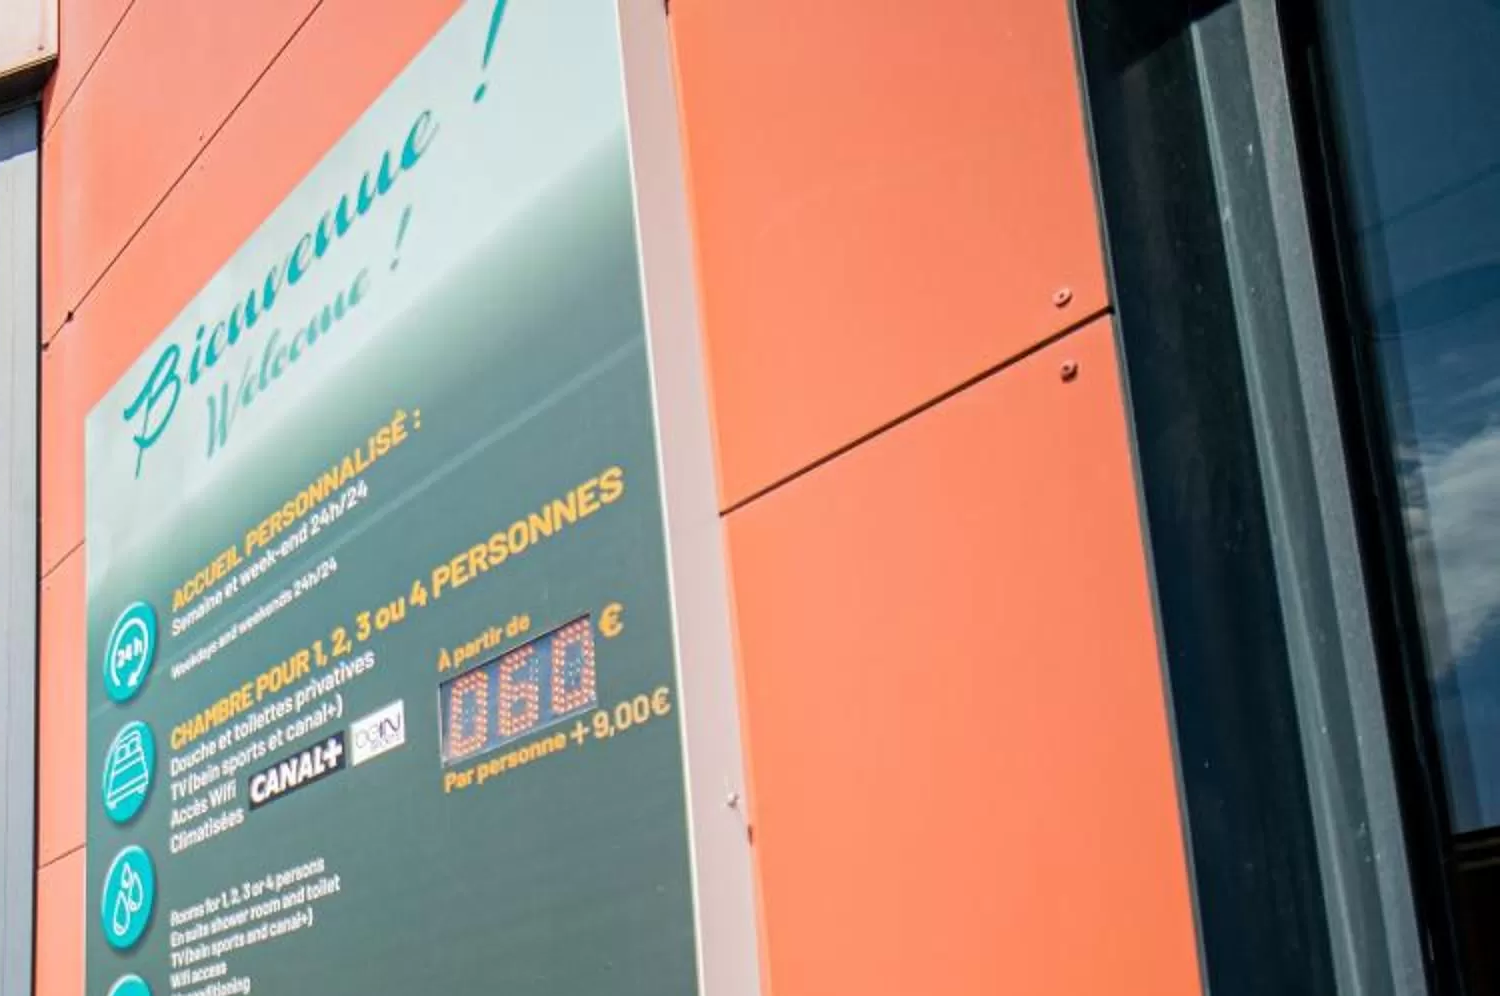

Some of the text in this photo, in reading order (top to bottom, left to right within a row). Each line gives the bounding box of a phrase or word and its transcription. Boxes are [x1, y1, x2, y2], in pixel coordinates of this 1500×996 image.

[123, 109, 438, 479] Bienvenue
[206, 268, 370, 459] Welcome
[171, 544, 243, 613] ACCUEIL
[245, 408, 408, 557] PERSONNALISÉ
[171, 479, 368, 637] Semaine et week-end 24h/24
[293, 556, 338, 598] 24h/24
[170, 683, 255, 750] CHAMBRE
[256, 649, 310, 701] POUR
[355, 611, 371, 641] 3
[375, 596, 406, 630] ou
[409, 579, 428, 607] 4
[431, 466, 625, 600] PERSONNES
[451, 625, 504, 669] partir
[505, 613, 531, 637] de
[599, 602, 624, 638] €
[170, 650, 375, 777] Douche et toilettes privatives
[222, 739, 267, 777] sports
[268, 730, 283, 751] et
[284, 692, 343, 745] canal+)
[444, 767, 474, 793] Par
[477, 732, 566, 784] personne
[593, 686, 673, 740] 9,00€
[170, 779, 237, 829] Accès Wifi
[250, 737, 343, 803] CANAL+
[170, 807, 244, 855] Climatisées
[249, 897, 280, 921] room
[281, 887, 304, 910] and
[305, 874, 341, 902] toilet
[211, 933, 245, 957] sports
[245, 923, 268, 945] and
